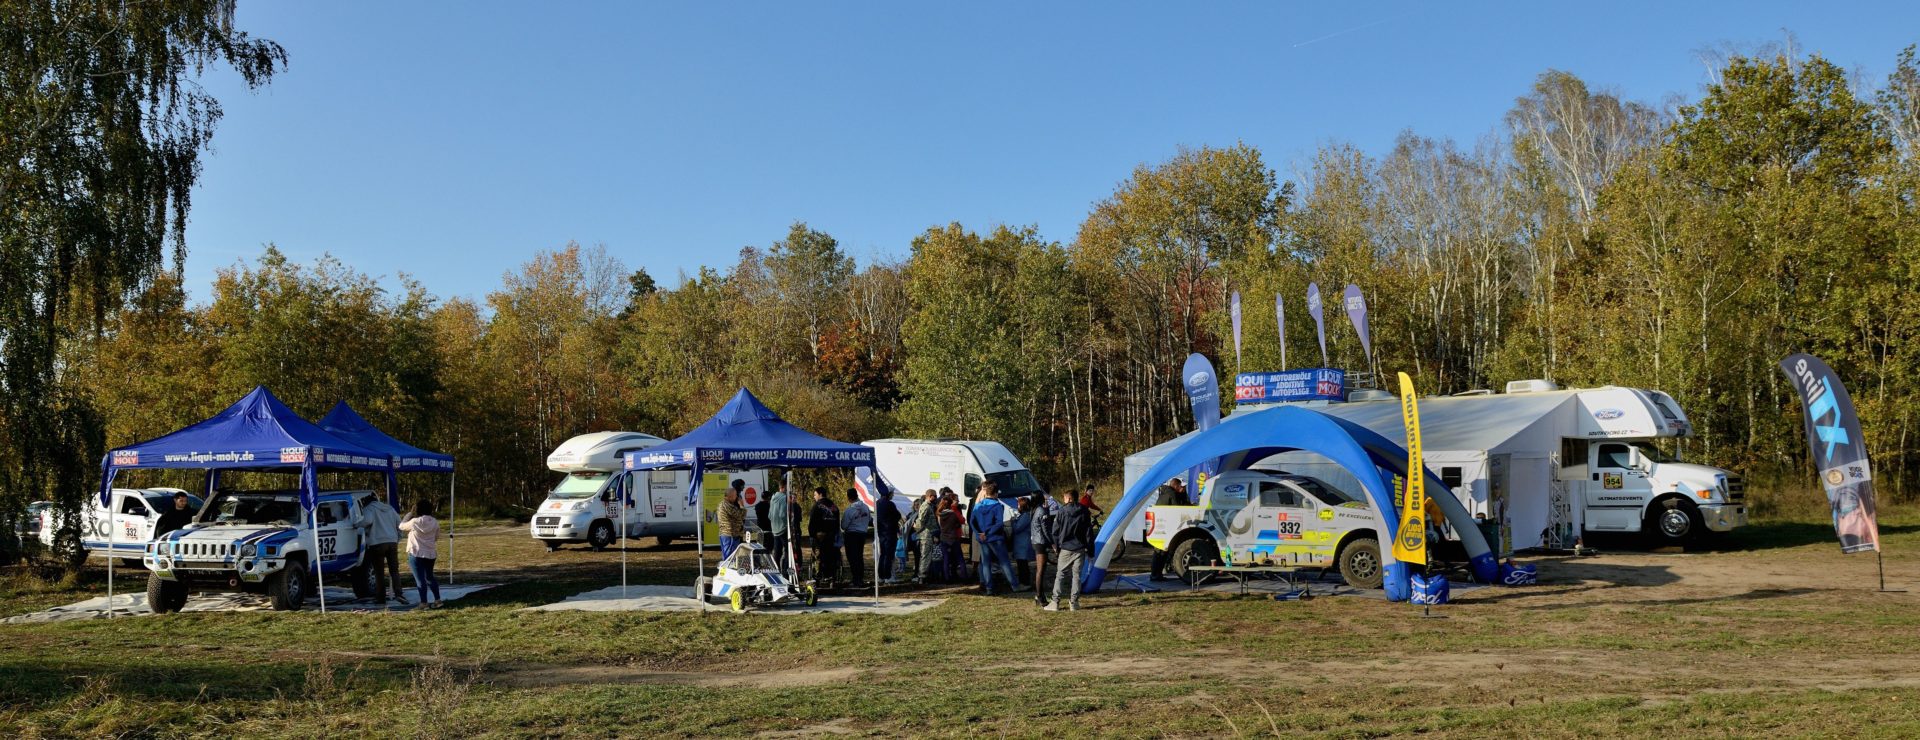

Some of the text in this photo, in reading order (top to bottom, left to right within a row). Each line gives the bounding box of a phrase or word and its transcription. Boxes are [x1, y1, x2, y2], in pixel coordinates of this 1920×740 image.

[1270, 372, 1312, 383] MOTORENÖLE
[1272, 388, 1310, 397] AUTOPFLEGE
[165, 451, 255, 463] www.liqui-moly.de
[730, 450, 871, 461] MOTOROILS ADDITIVES CAR CARE
[607, 506, 617, 515] 955
[125, 527, 137, 537] 332
[1280, 521, 1301, 535] 332
[318, 537, 336, 555] 332
